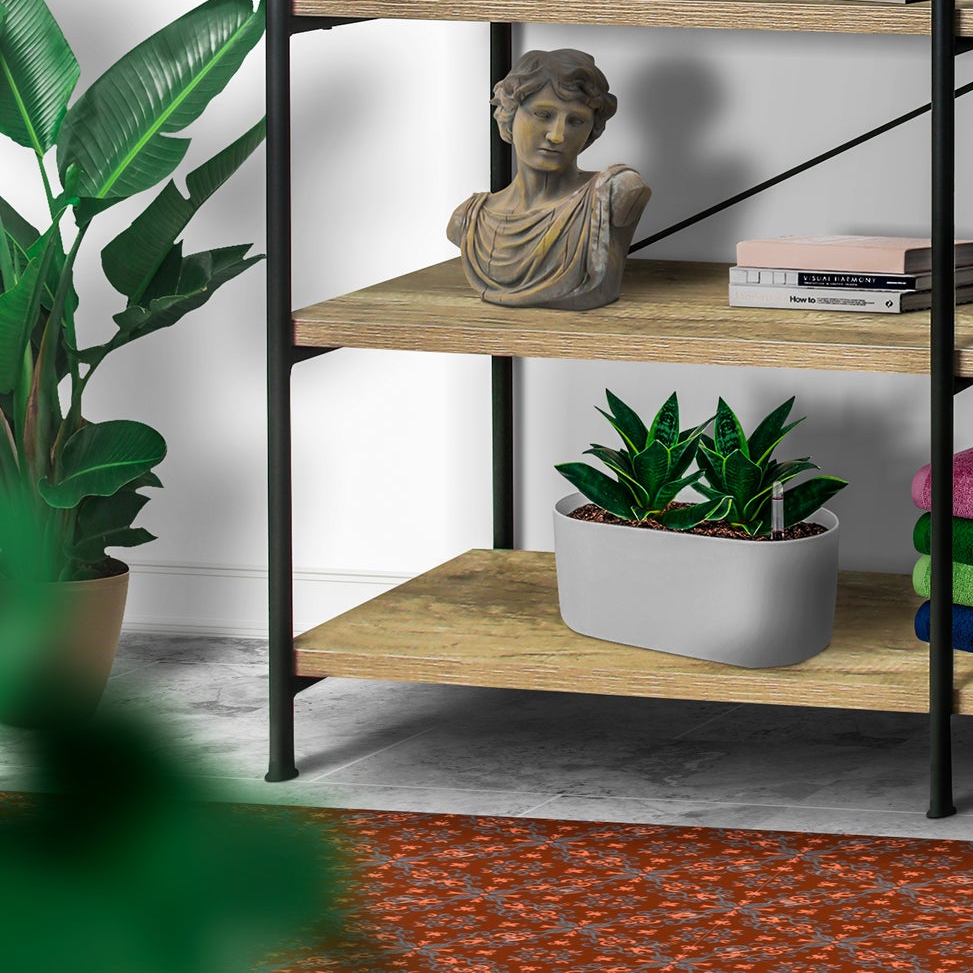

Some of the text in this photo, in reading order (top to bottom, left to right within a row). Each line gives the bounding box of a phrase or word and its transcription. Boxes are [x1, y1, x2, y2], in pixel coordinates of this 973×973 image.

[803, 275, 831, 283] VISUAL
[834, 276, 877, 284] HARMONY
[789, 295, 807, 303] How
[808, 296, 816, 304] to
